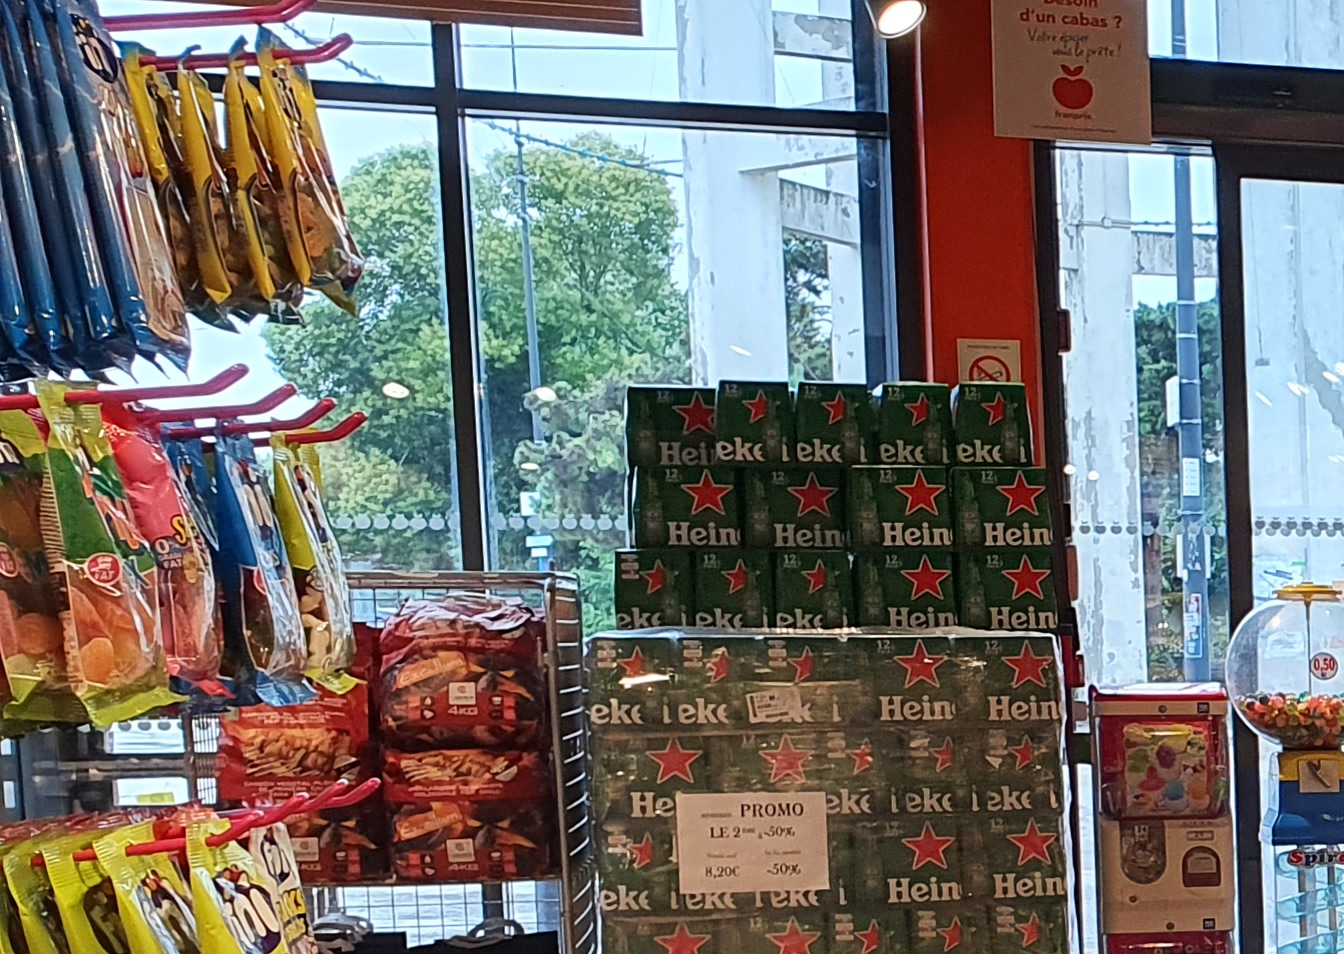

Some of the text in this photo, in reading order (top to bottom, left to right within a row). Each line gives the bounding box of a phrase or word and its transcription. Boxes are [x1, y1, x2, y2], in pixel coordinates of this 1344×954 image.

[1061, 13, 1108, 28] cabas
[1114, 16, 1123, 29] ?
[1313, 657, 1336, 672] 0,50
[740, 803, 804, 818] PROMO
[710, 826, 796, 838] LE -50%
[705, 866, 740, 879] 8,20€
[767, 863, 801, 876] -50%
